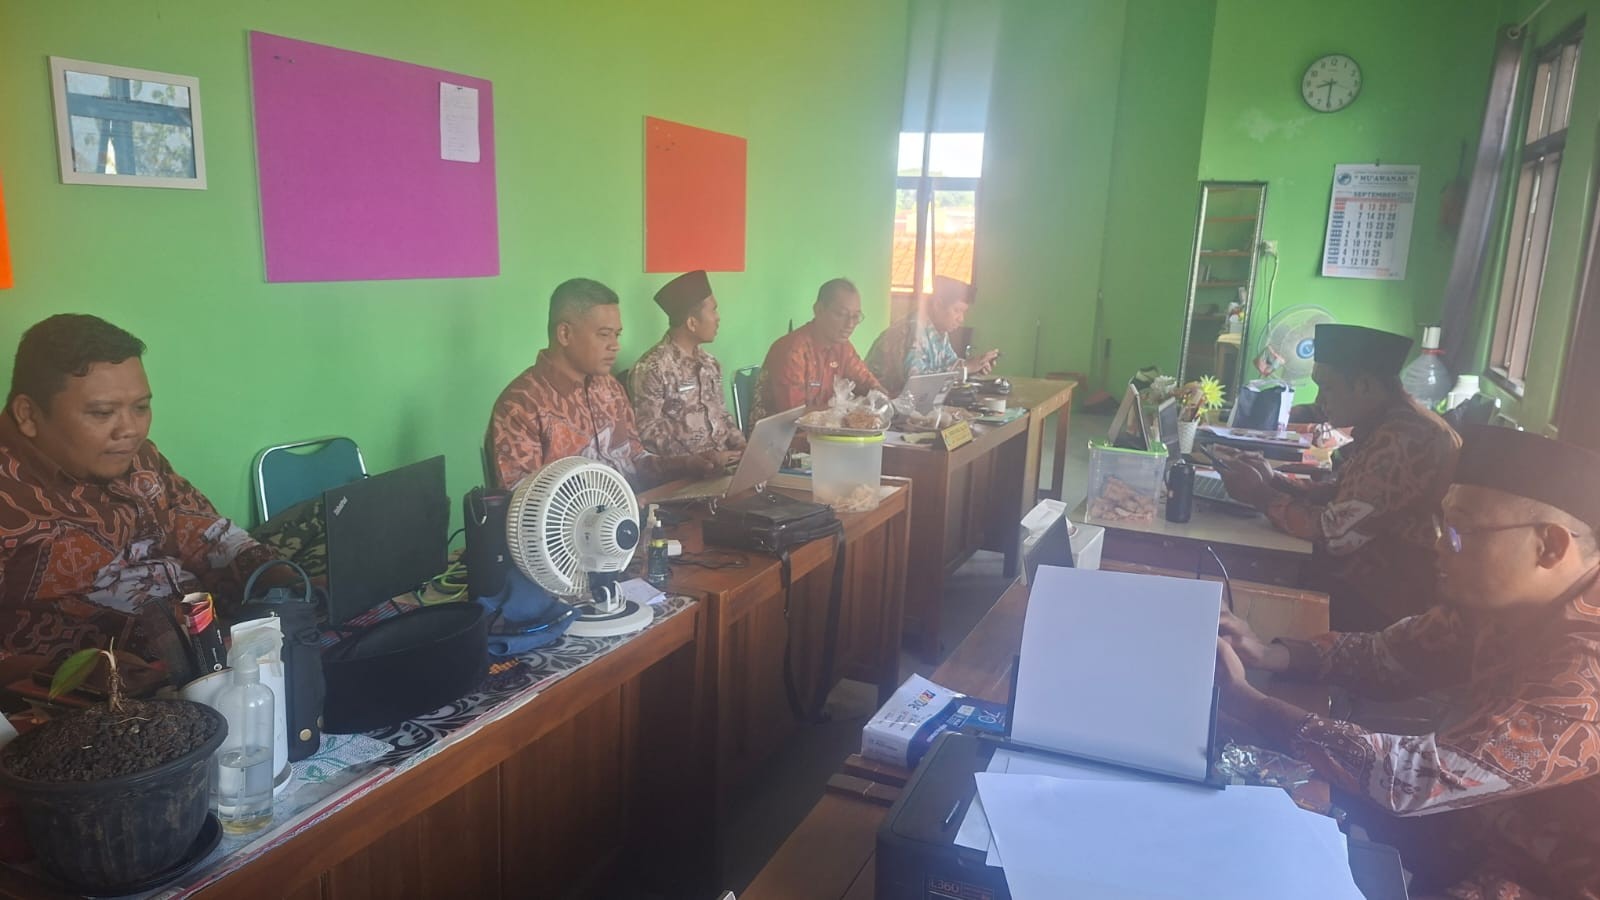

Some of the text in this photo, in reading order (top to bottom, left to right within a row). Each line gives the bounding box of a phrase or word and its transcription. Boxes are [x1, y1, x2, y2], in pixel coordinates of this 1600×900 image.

[1376, 222, 1384, 230] 22
[1364, 240, 1370, 248] 17
[1373, 240, 1381, 248] 24
[1371, 258, 1379, 266] 26
